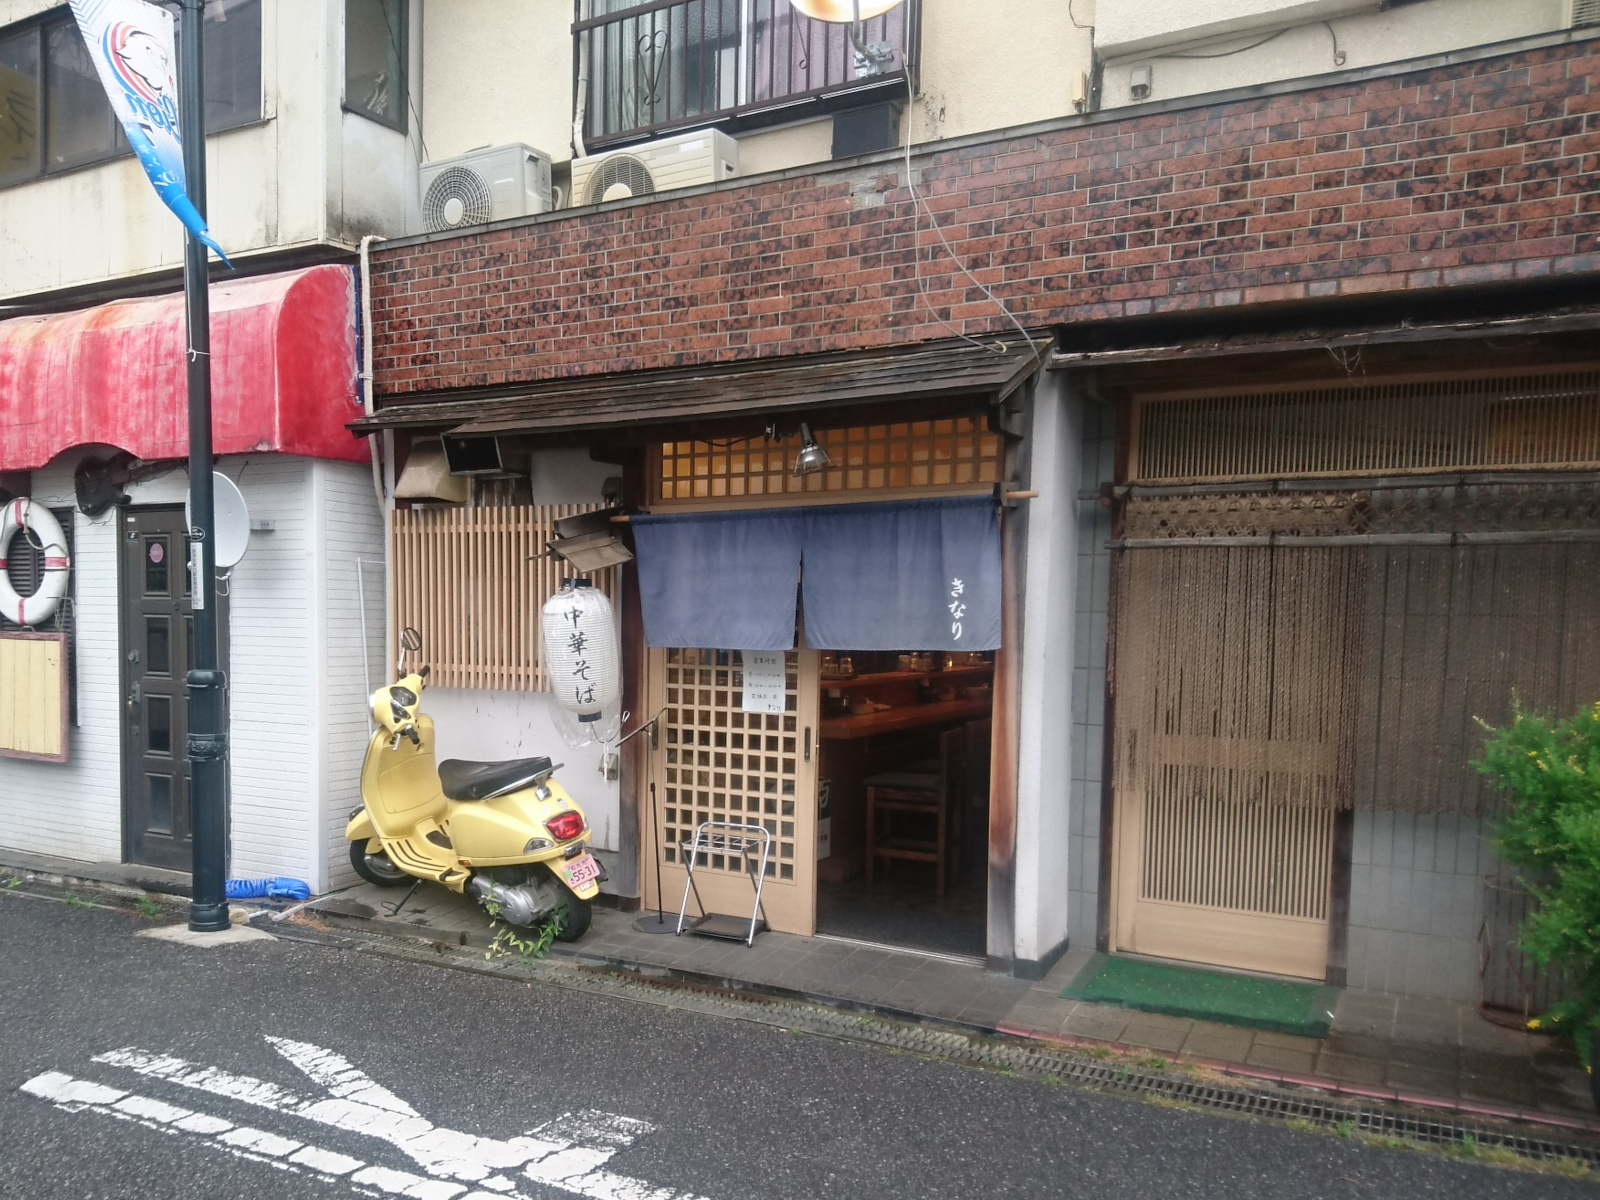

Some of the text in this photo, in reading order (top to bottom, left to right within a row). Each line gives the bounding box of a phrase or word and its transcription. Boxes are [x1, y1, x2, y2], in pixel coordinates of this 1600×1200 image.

[948, 577, 967, 641] きなり
[563, 605, 597, 705] 中華そば
[573, 864, 596, 881] 55-31
